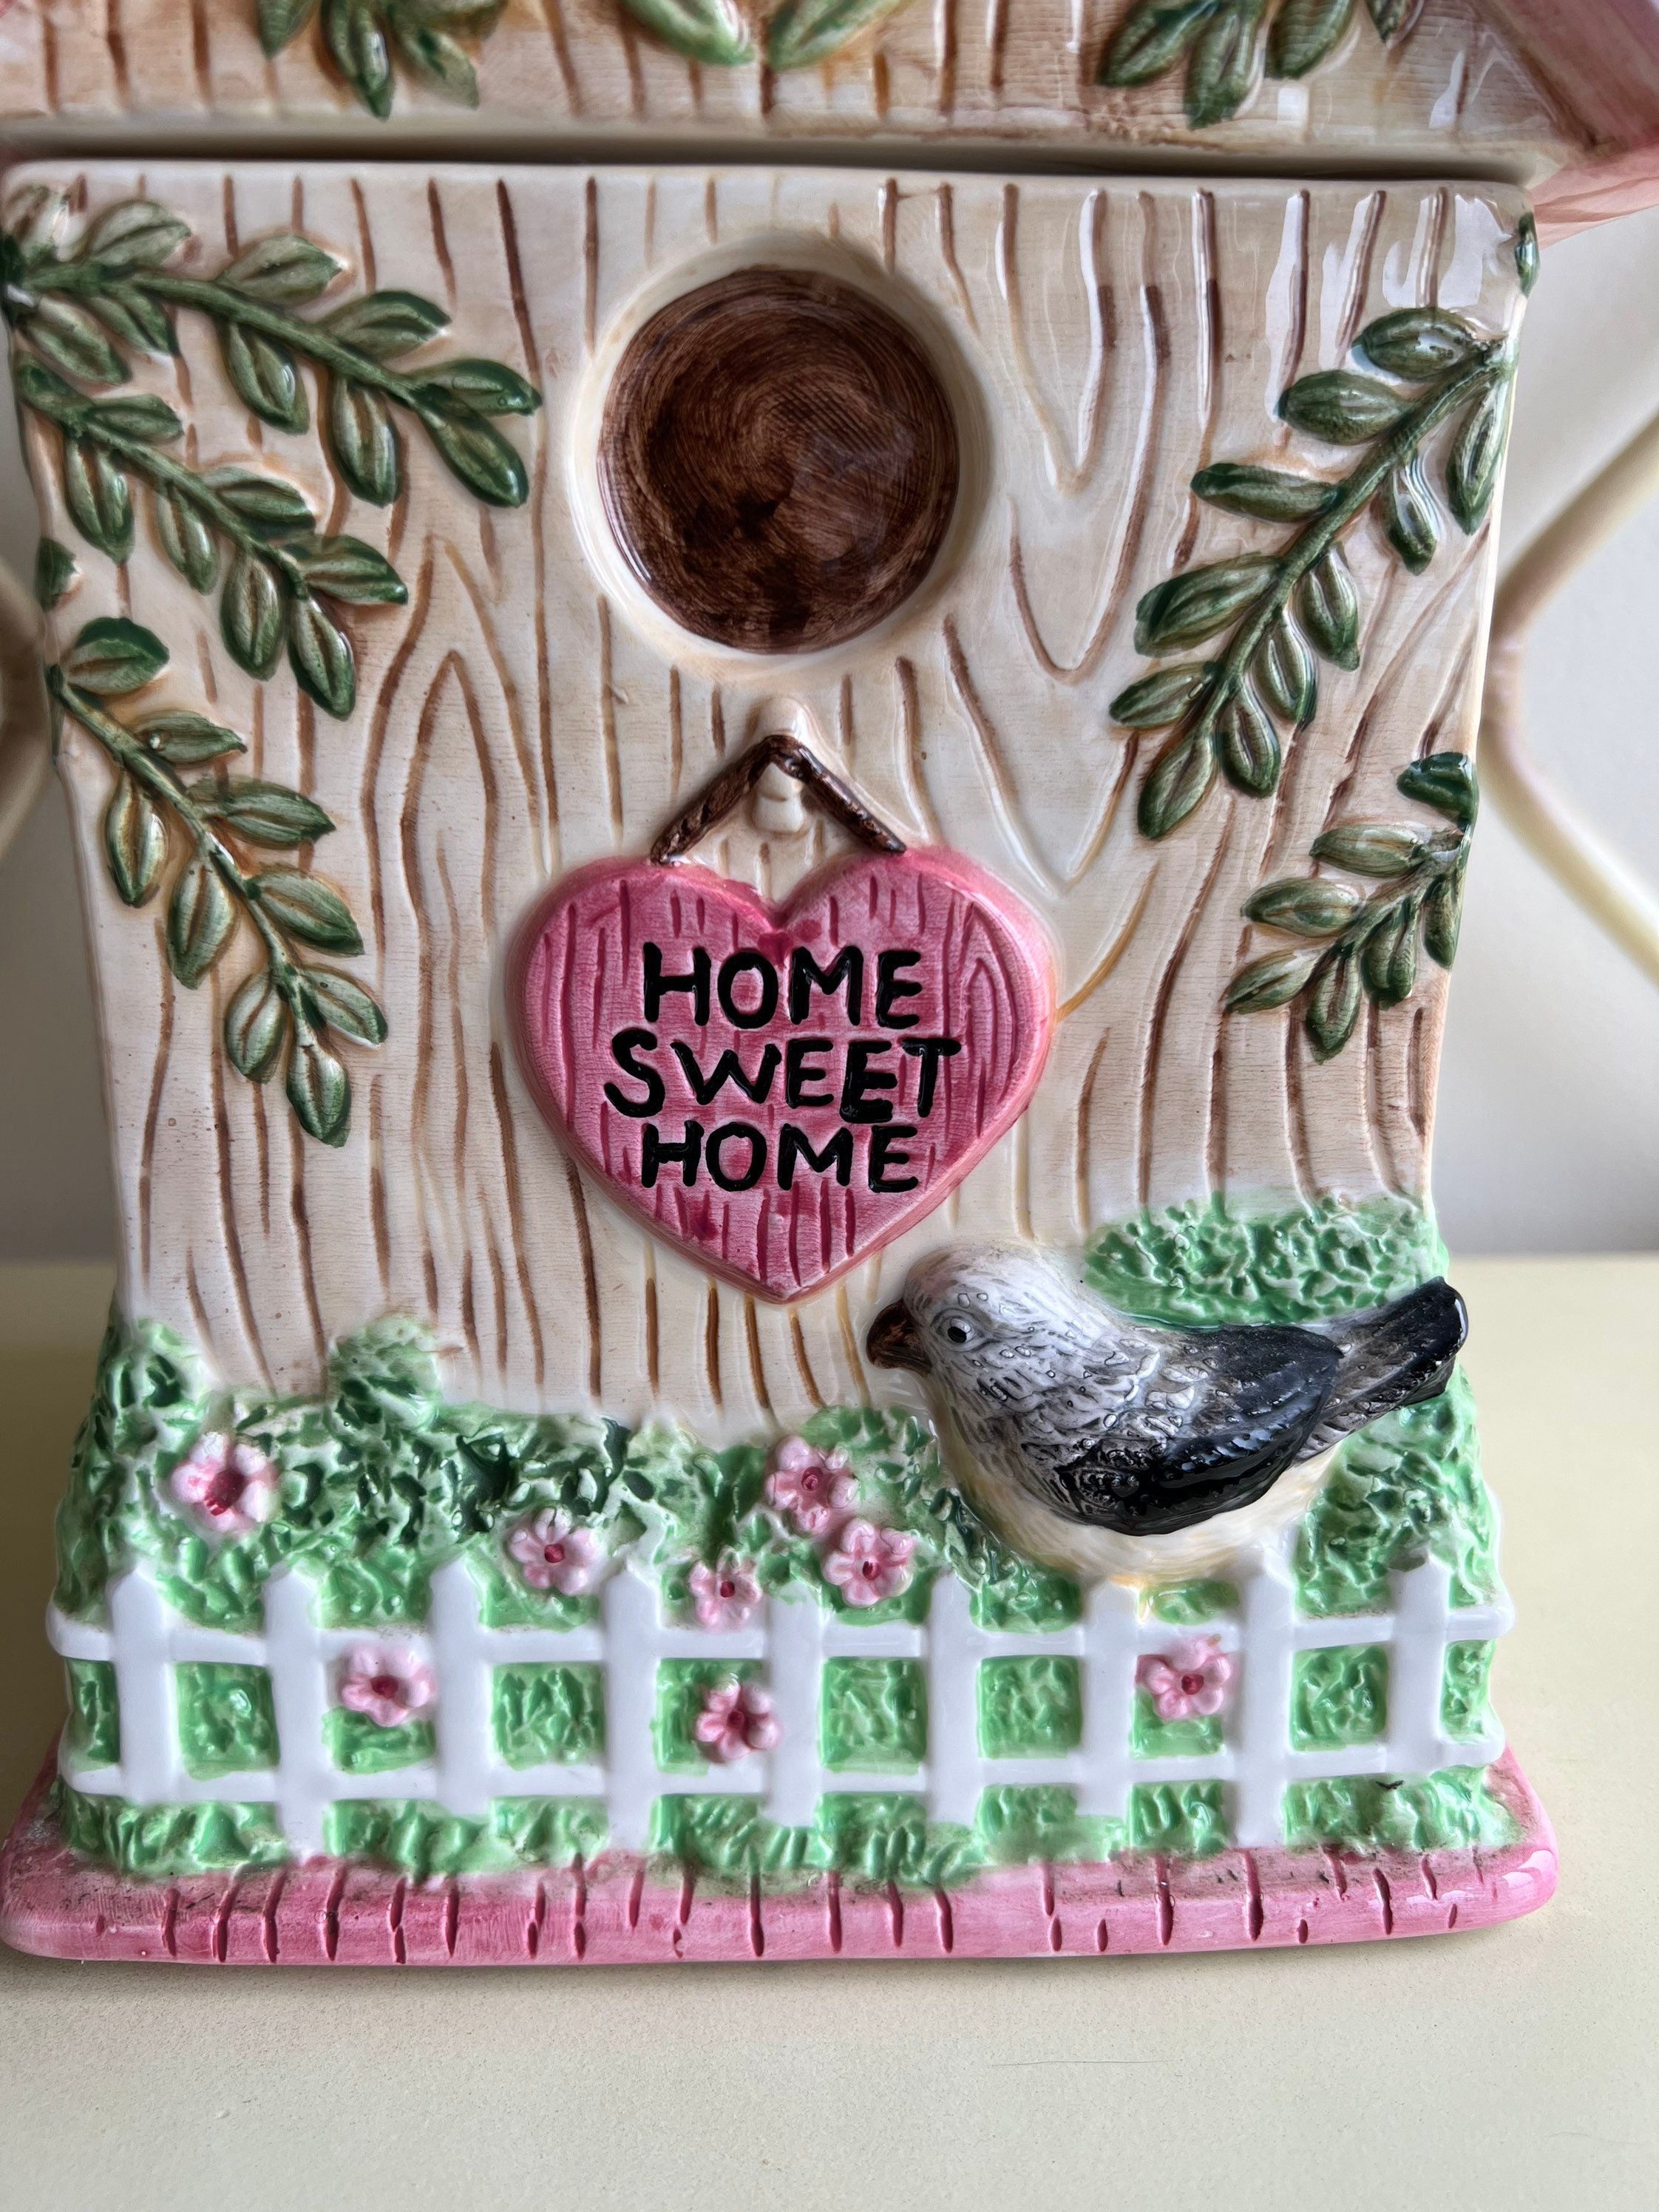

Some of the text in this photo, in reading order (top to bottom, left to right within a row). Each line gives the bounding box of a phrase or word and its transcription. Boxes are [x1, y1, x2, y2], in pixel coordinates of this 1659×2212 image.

[642, 941, 923, 1030] HOME
[603, 1027, 962, 1124] SWEET
[640, 1119, 920, 1194] HOME
